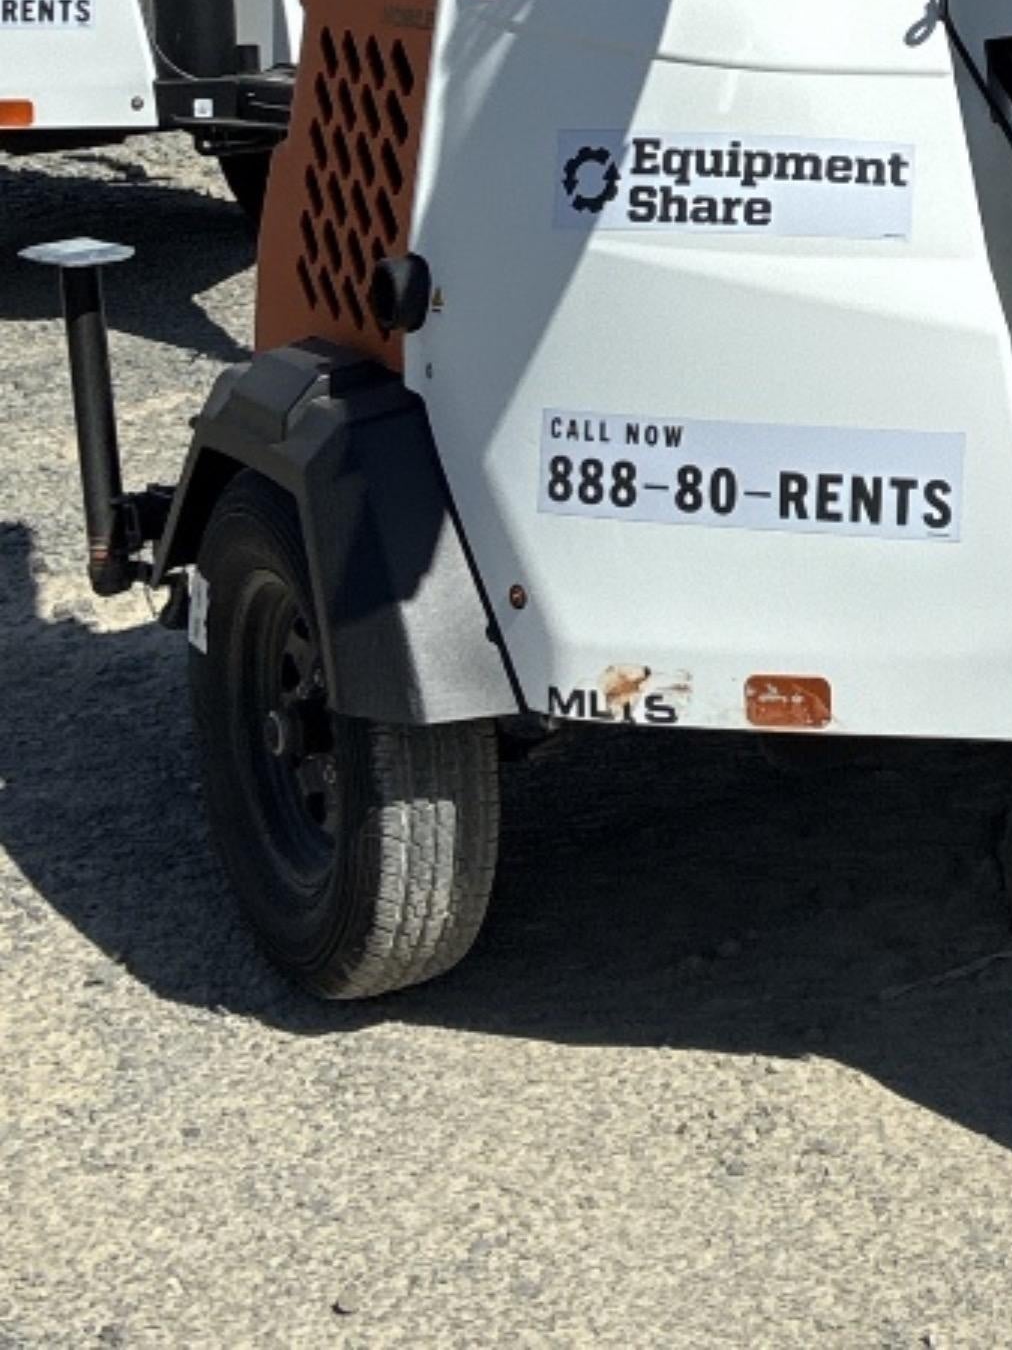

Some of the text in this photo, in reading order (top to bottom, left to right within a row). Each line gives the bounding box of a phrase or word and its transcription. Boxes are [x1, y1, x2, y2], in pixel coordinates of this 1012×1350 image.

[630, 137, 910, 187] Equipment
[627, 185, 772, 227] Share
[551, 416, 684, 449] CALL NOW
[547, 454, 954, 530] 888-80-RENTS
